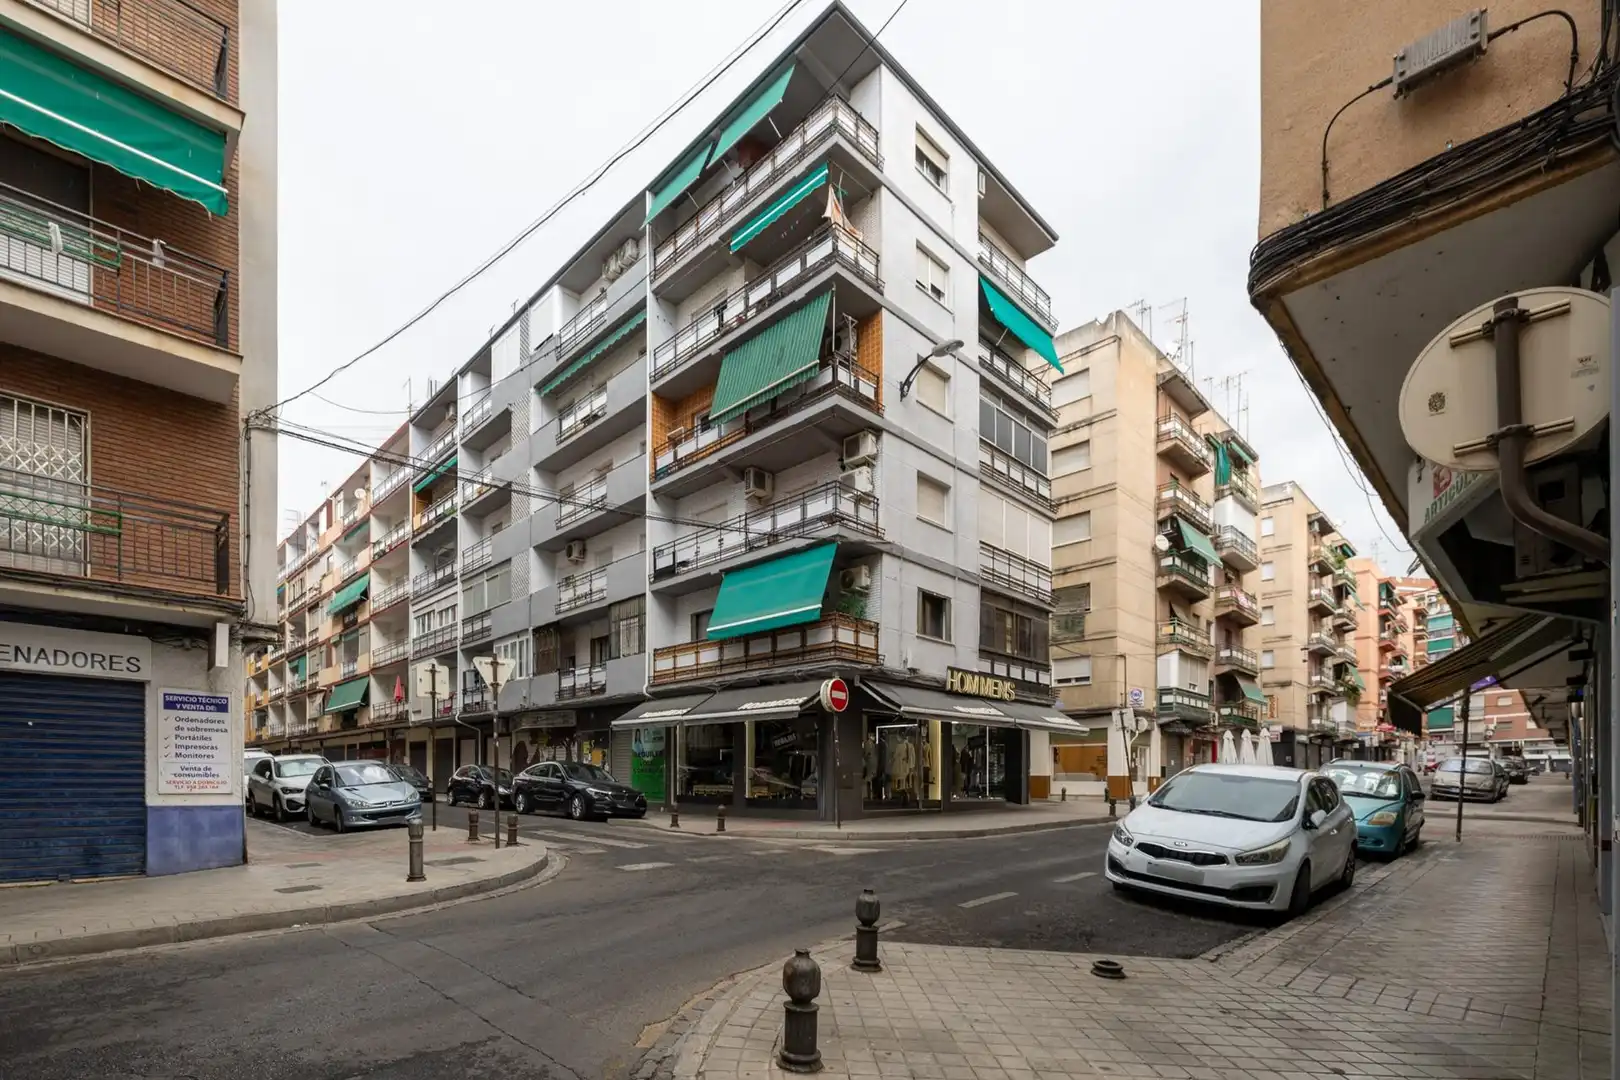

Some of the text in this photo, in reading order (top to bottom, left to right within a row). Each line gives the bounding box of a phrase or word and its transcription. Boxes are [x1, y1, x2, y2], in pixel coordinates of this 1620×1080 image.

[174, 716, 225, 724] Ordenadores
[174, 734, 212, 742] Portátiles
[174, 743, 218, 751] Impresoras
[174, 752, 214, 760] Monitores
[180, 765, 201, 773] Venta
[173, 771, 220, 779] consumibles
